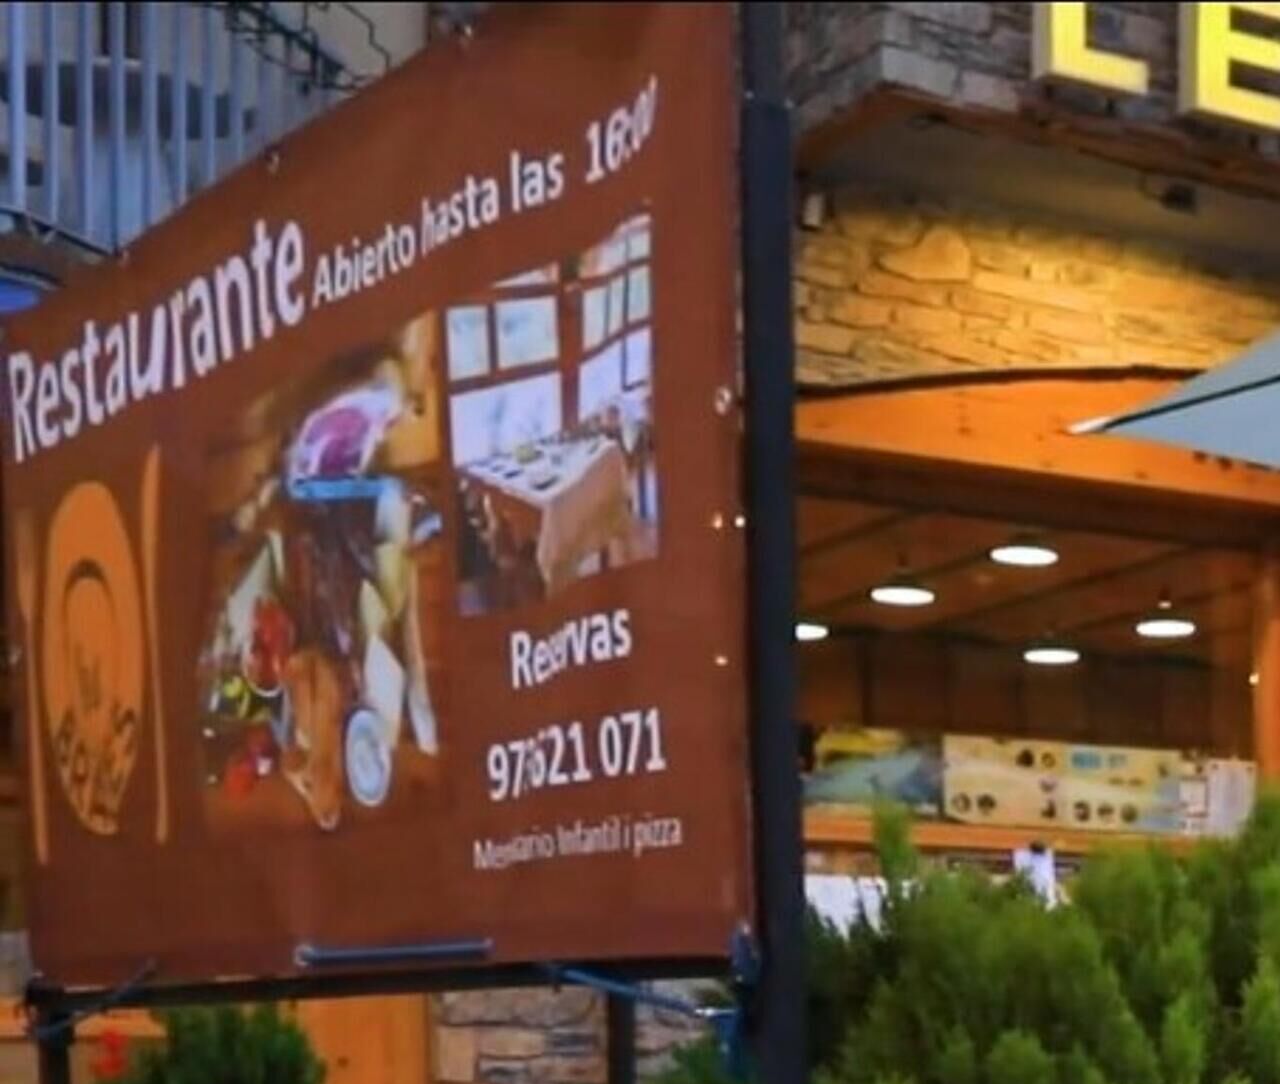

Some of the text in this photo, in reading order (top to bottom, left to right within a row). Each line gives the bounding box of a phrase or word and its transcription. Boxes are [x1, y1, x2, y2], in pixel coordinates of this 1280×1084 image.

[9, 218, 306, 463] Restaurante
[311, 221, 417, 309] Abierto
[422, 174, 499, 257] hasta
[510, 151, 565, 213] las
[598, 706, 666, 779] 071
